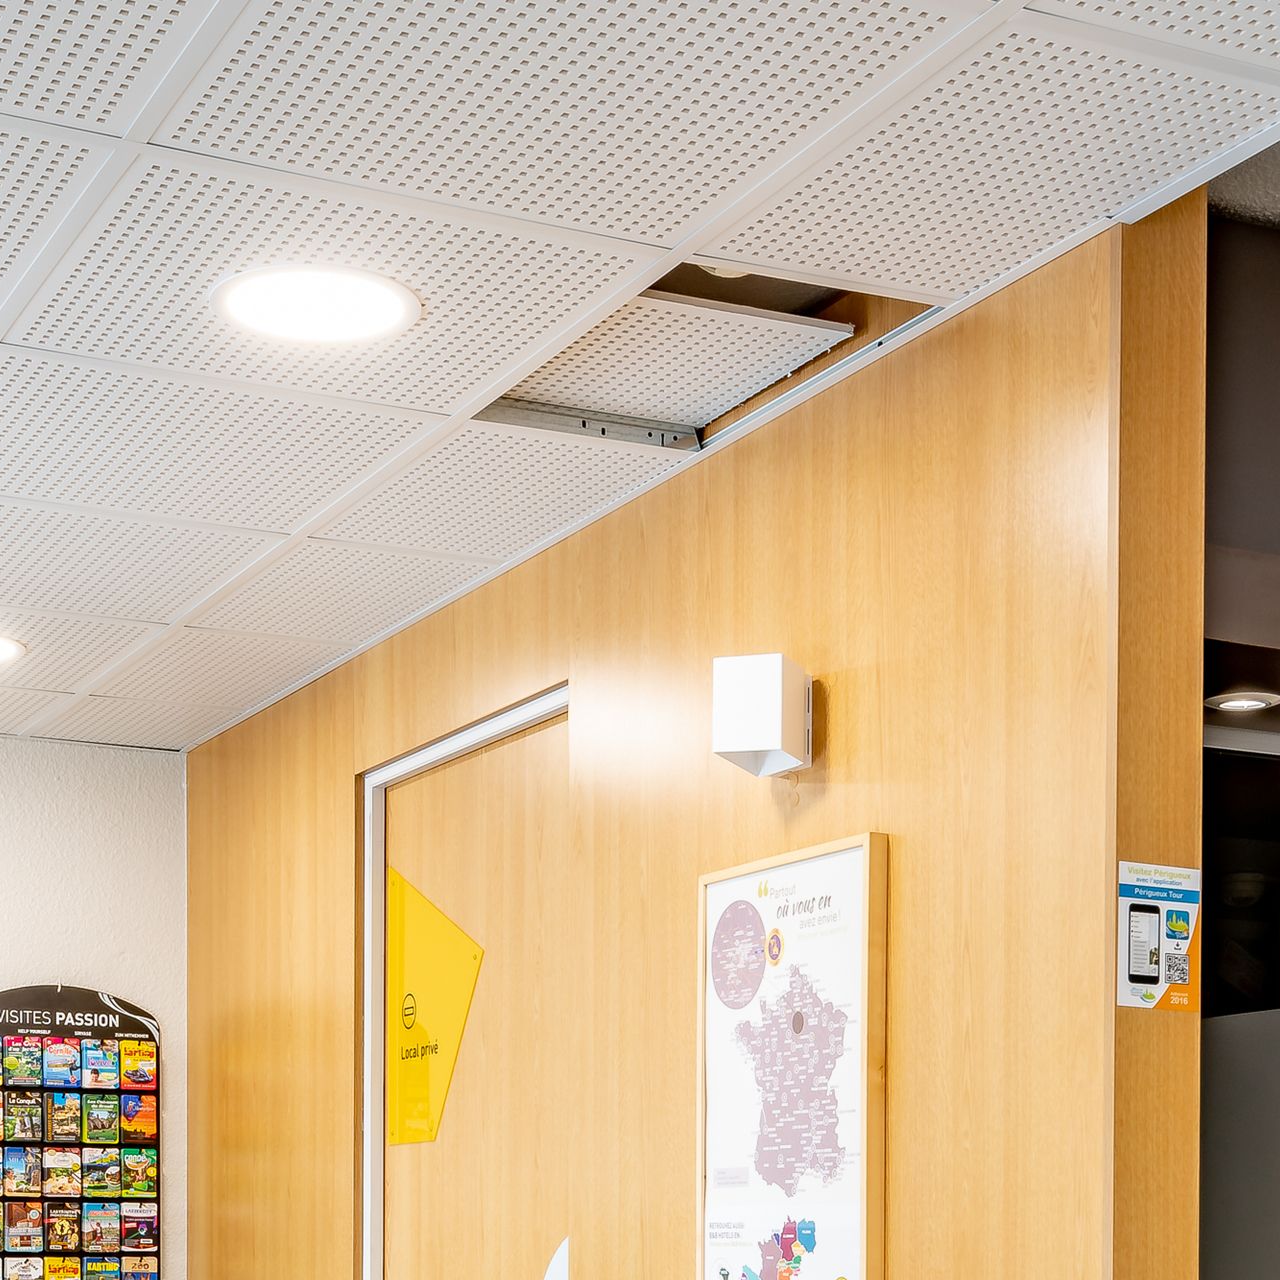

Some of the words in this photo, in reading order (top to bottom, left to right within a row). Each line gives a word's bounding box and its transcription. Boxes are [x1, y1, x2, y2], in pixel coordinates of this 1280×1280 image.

[1127, 866, 1153, 876] Visitez
[769, 884, 796, 899] Partout
[1134, 887, 1168, 898] Périgueux
[1168, 891, 1184, 899] Tour
[776, 898, 790, 920] où
[792, 896, 816, 916] vous
[818, 895, 832, 911] en
[1170, 996, 1189, 1005] 2016
[55, 1012, 120, 1028] PASSION
[400, 1043, 419, 1060] Local
[420, 1039, 439, 1060] privé
